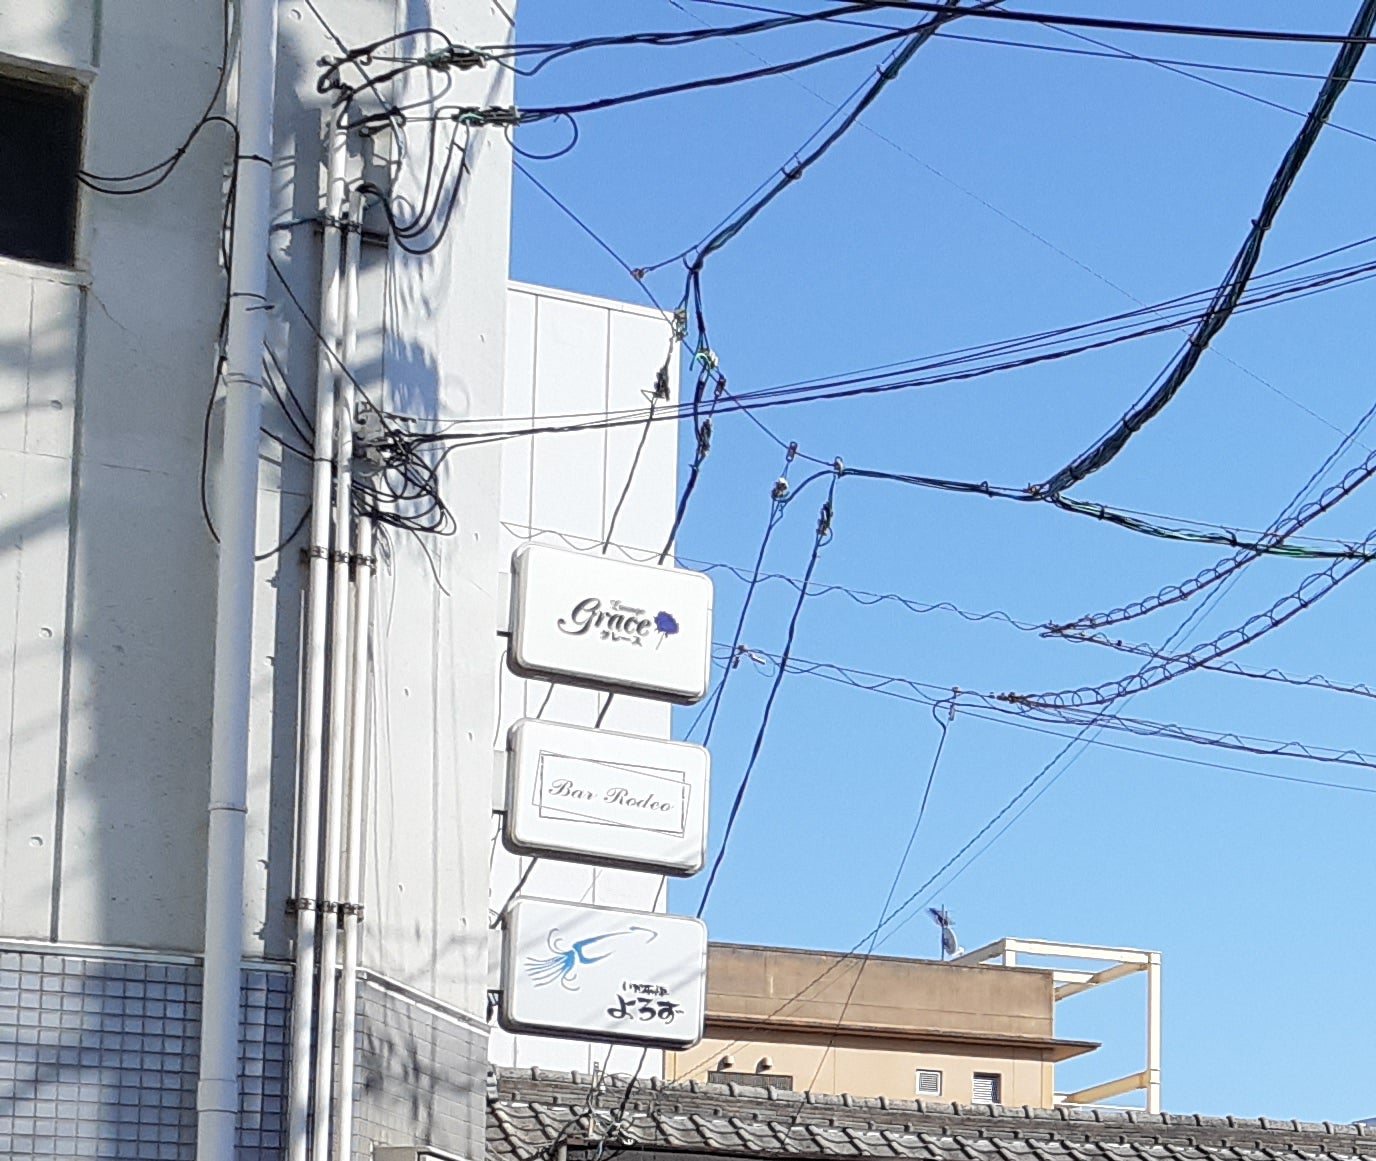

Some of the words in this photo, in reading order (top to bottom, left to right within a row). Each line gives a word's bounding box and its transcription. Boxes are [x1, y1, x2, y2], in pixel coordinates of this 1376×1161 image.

[557, 597, 652, 636] Grace
[548, 778, 598, 801] Bar
[603, 787, 675, 812] Rodeo
[606, 993, 685, 1025] よろず
